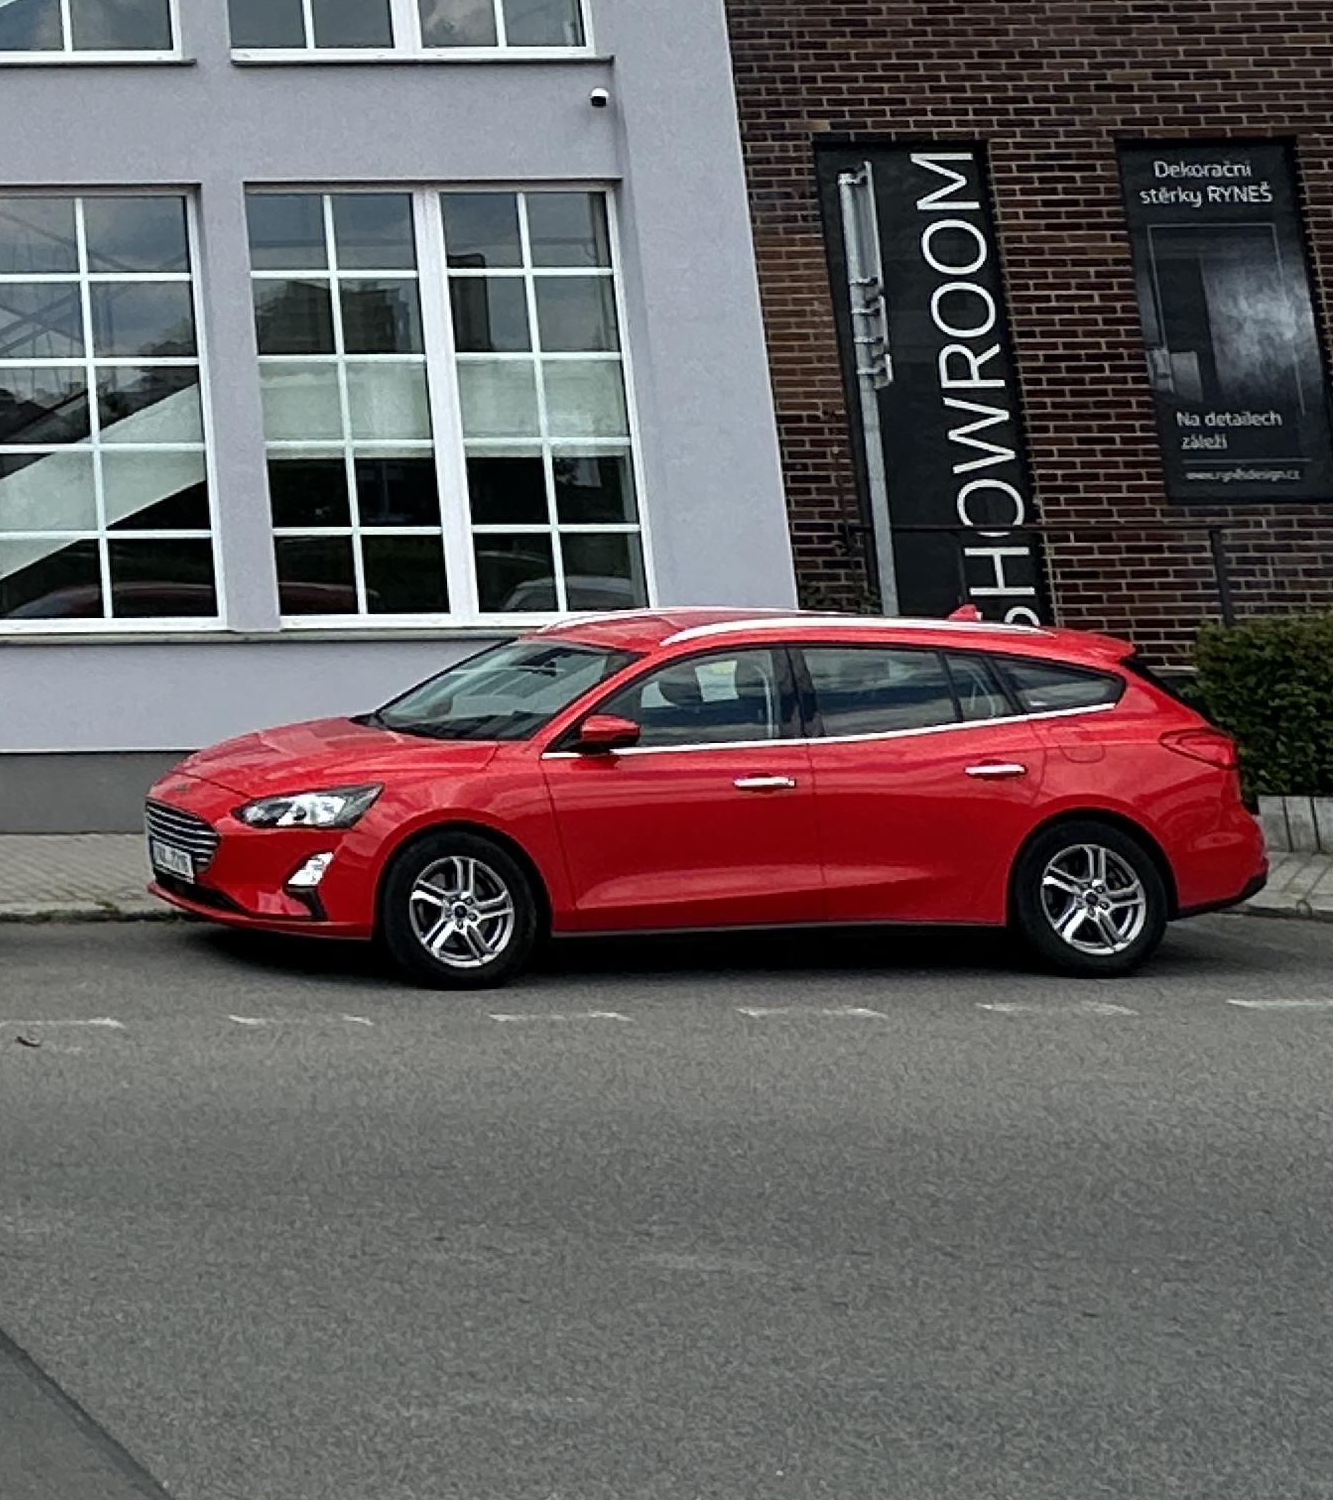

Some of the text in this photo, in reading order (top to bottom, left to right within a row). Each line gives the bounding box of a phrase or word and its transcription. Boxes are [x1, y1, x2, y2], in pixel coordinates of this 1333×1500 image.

[1153, 160, 1252, 178] Dekorační
[1139, 181, 1274, 208] stěrky RYNEŠ
[1176, 410, 1283, 427] Na detailech
